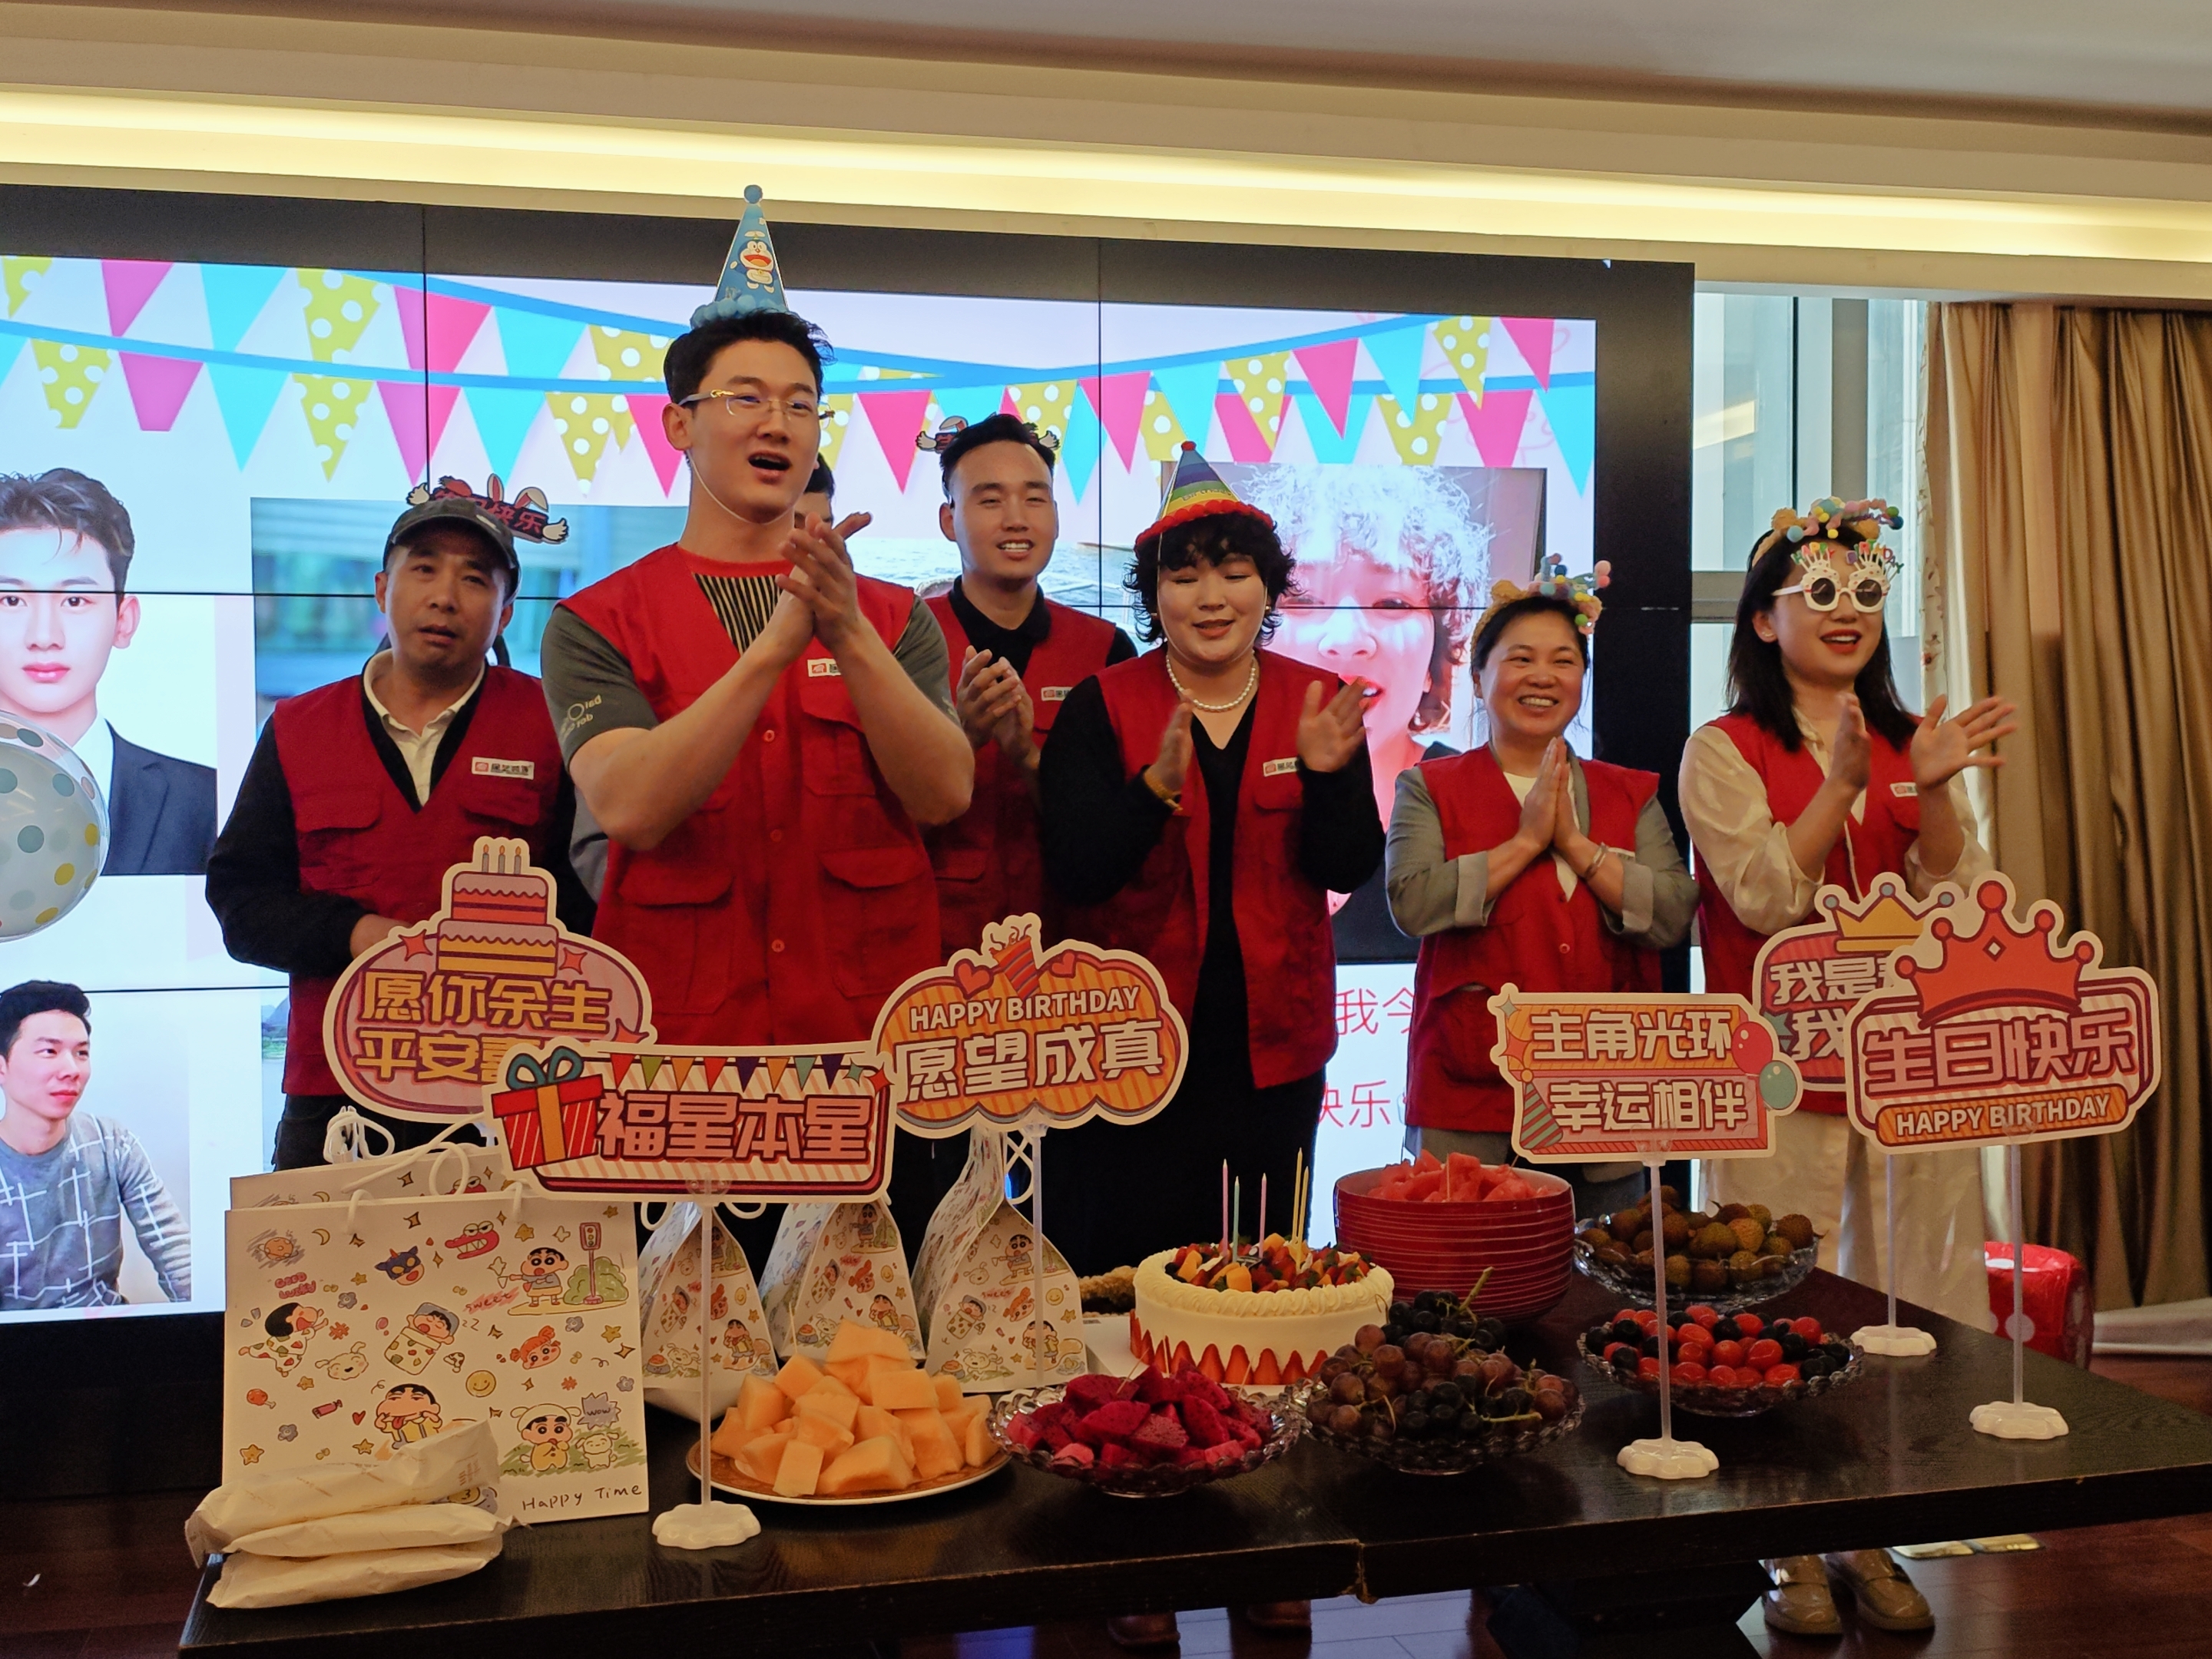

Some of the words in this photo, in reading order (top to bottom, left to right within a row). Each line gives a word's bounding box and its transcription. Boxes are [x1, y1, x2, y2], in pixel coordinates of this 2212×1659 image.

[362, 971, 611, 1033] 愿你余生
[1770, 957, 1892, 1005] 我是
[910, 997, 1000, 1032] HAPPY
[1007, 985, 1141, 1023] BIRTHDAY
[895, 1020, 1164, 1102] 愿望成真
[1531, 1011, 1732, 1061] 主角光环
[1865, 1008, 2133, 1094] 生日快乐
[599, 1091, 871, 1161] 福星本星
[1549, 1081, 1748, 1131] 幸运相伴
[1896, 1106, 1984, 1137] HAPPY
[1989, 1094, 2111, 1129] BIRTHDAY
[522, 1492, 582, 1511] Happy
[594, 1485, 642, 1499] Time
